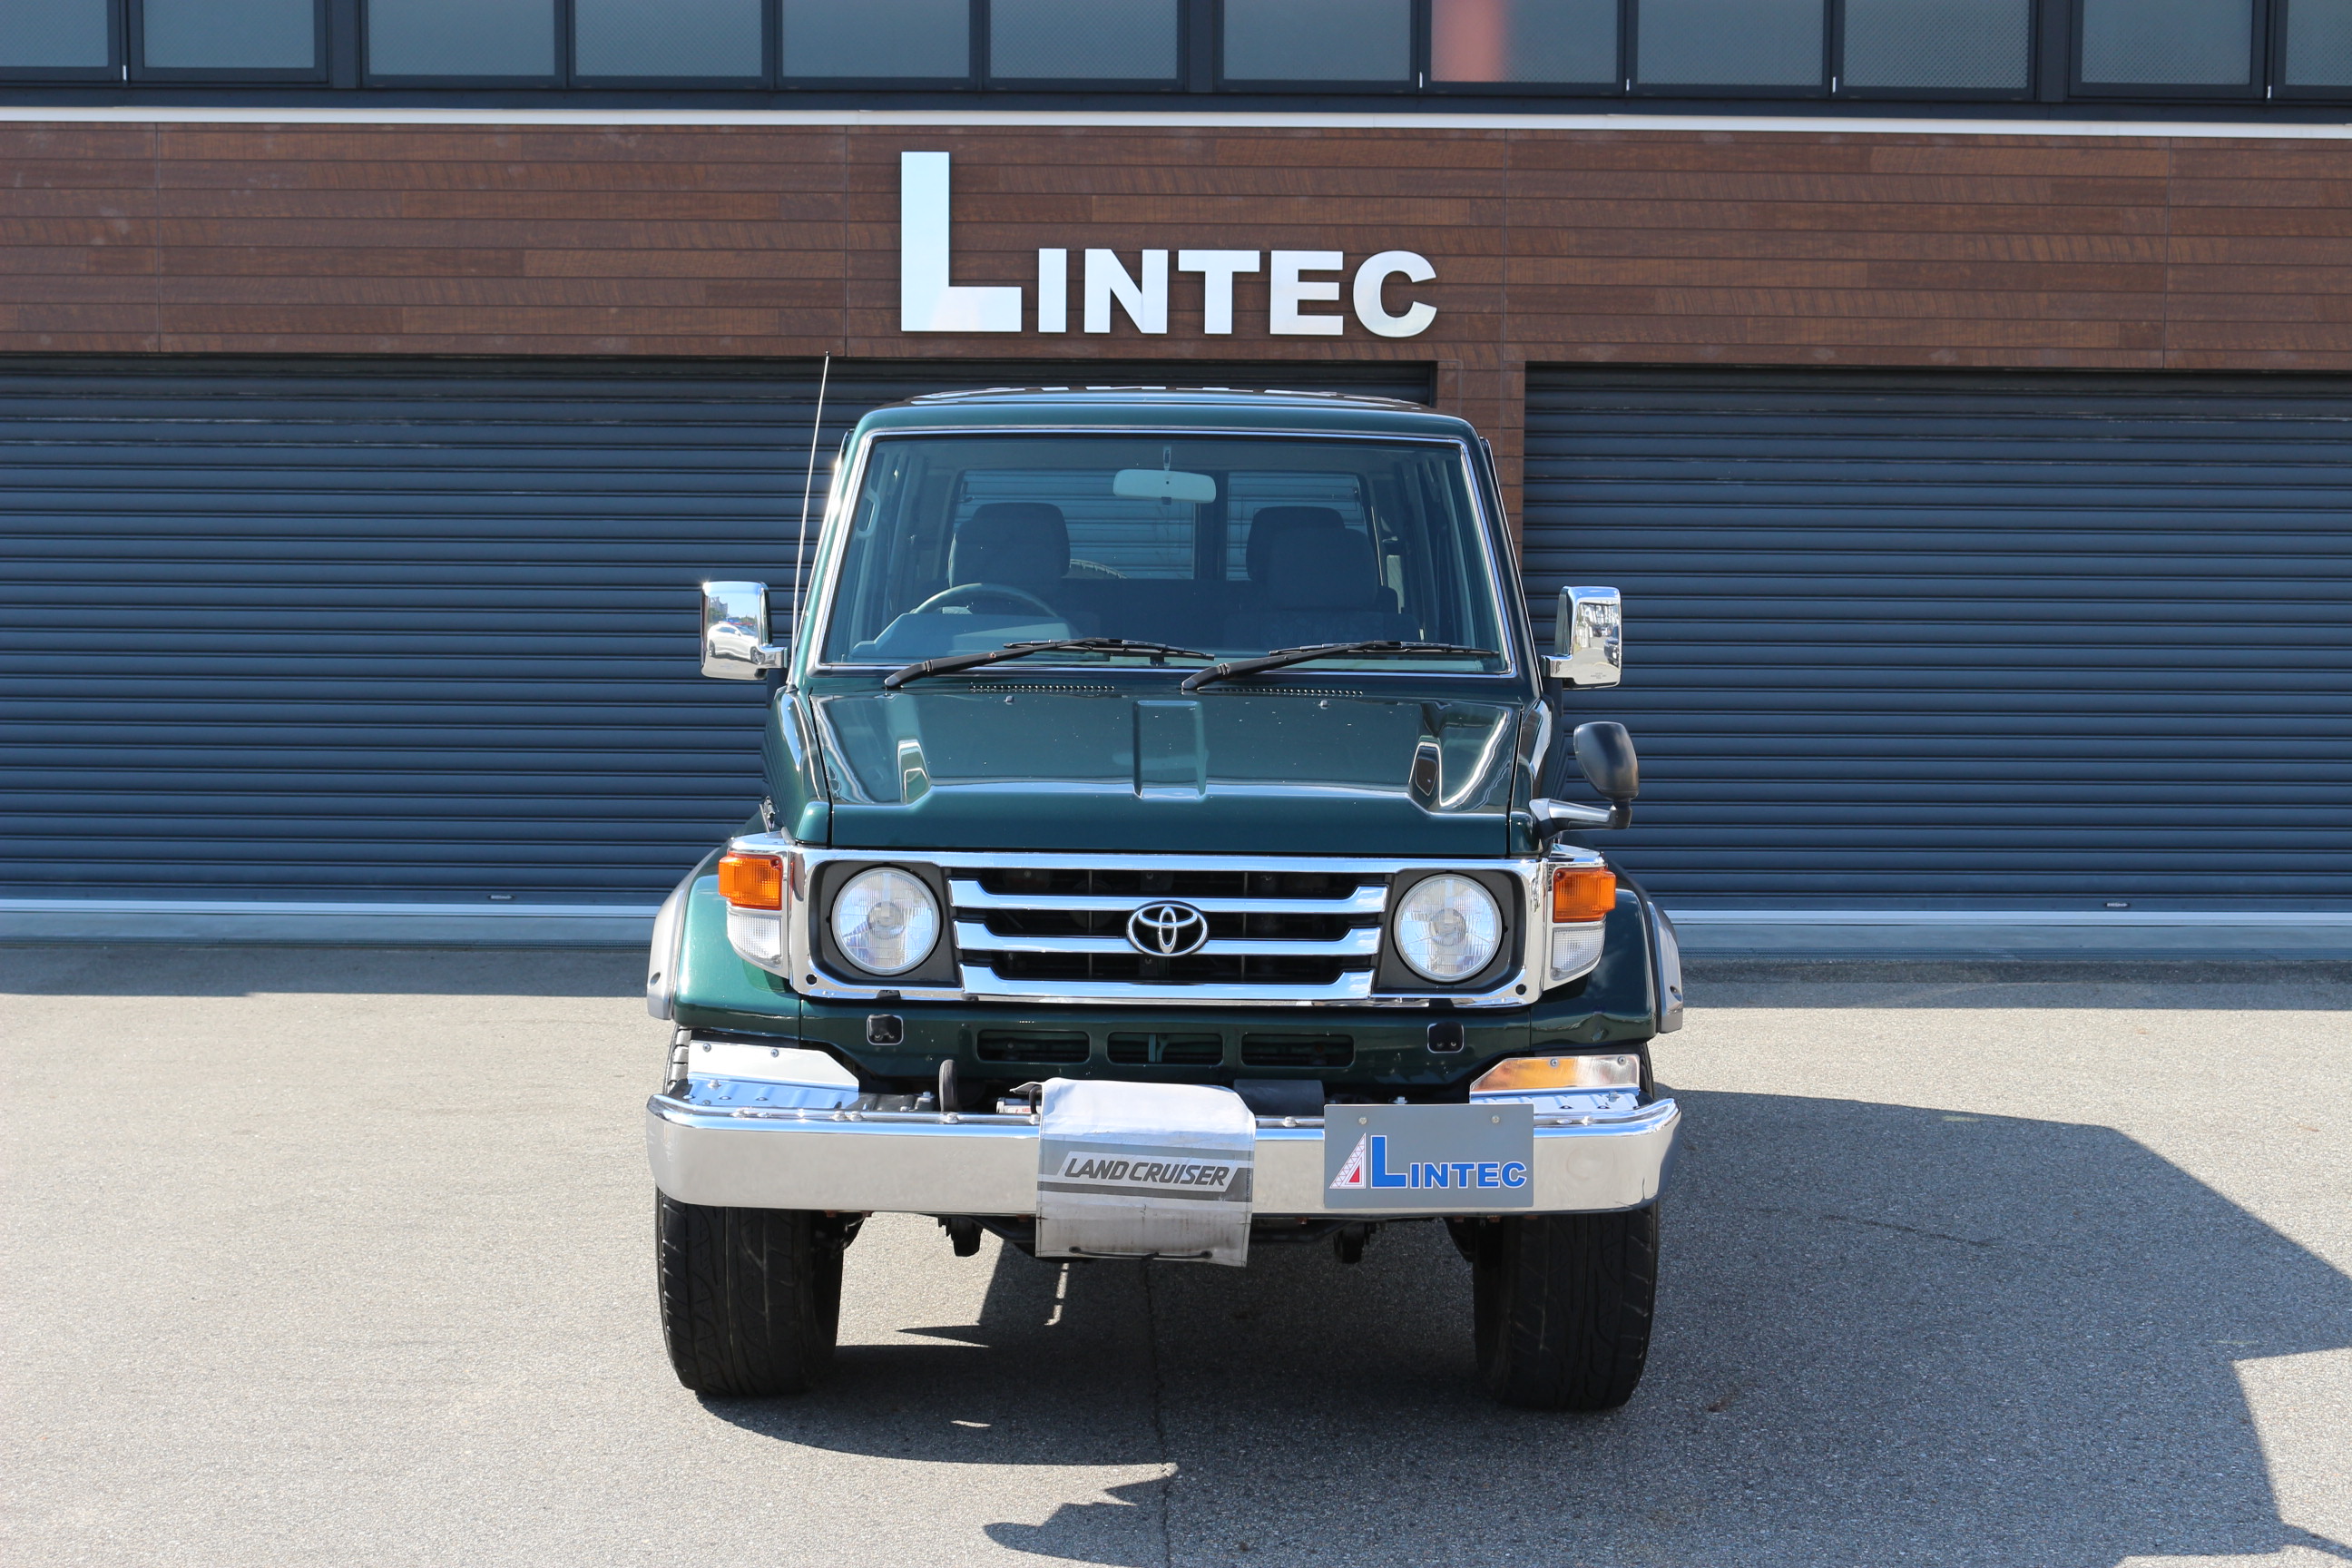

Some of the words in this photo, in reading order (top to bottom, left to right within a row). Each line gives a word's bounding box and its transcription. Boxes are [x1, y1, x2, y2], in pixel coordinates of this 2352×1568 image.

[901, 152, 1437, 338] LINTEC
[1064, 1158, 1129, 1180] LAND
[1129, 1162, 1230, 1186] CRUISER
[1371, 1135, 1527, 1189] LINTEC
